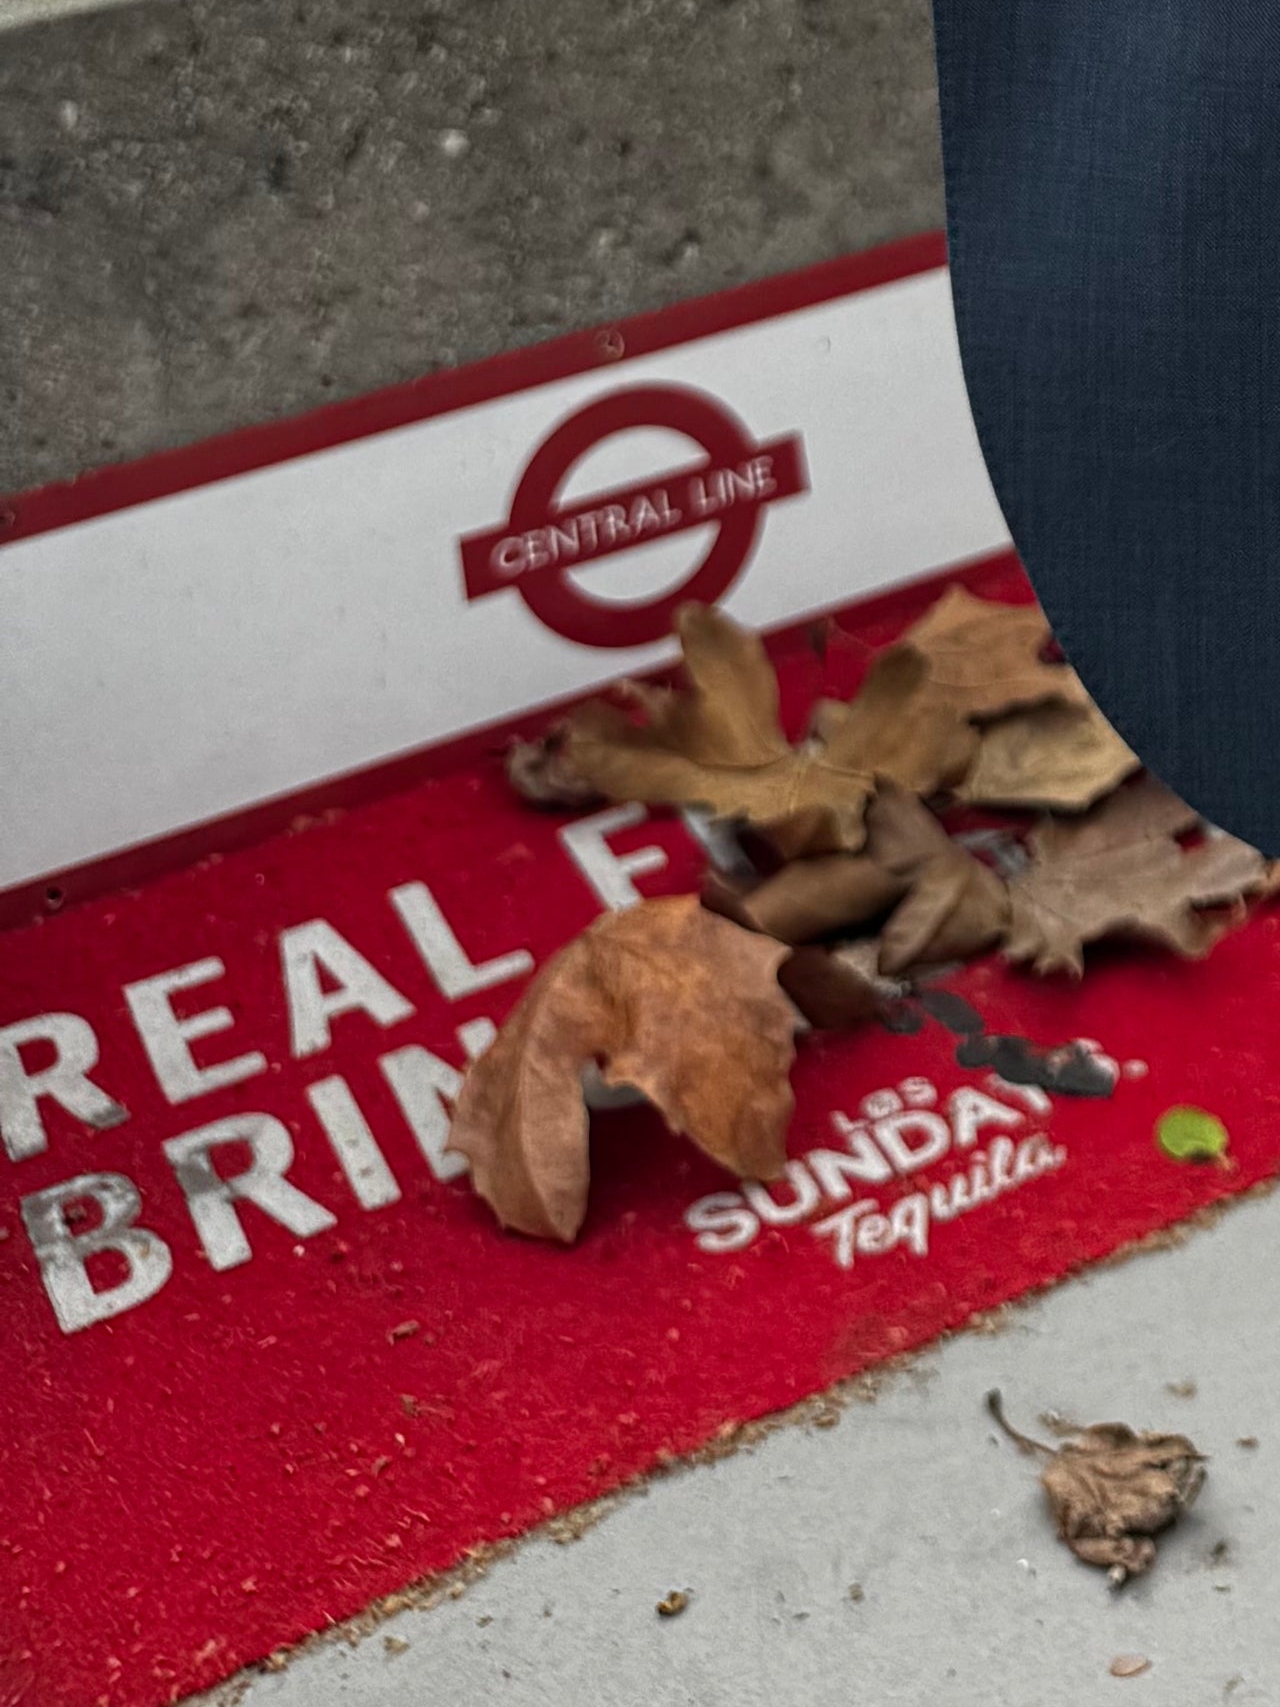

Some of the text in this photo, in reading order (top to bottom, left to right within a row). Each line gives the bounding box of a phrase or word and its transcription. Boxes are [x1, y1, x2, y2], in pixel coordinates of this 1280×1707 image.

[490, 455, 777, 578] CENTRAL LINE
[0, 881, 535, 1163] REAL
